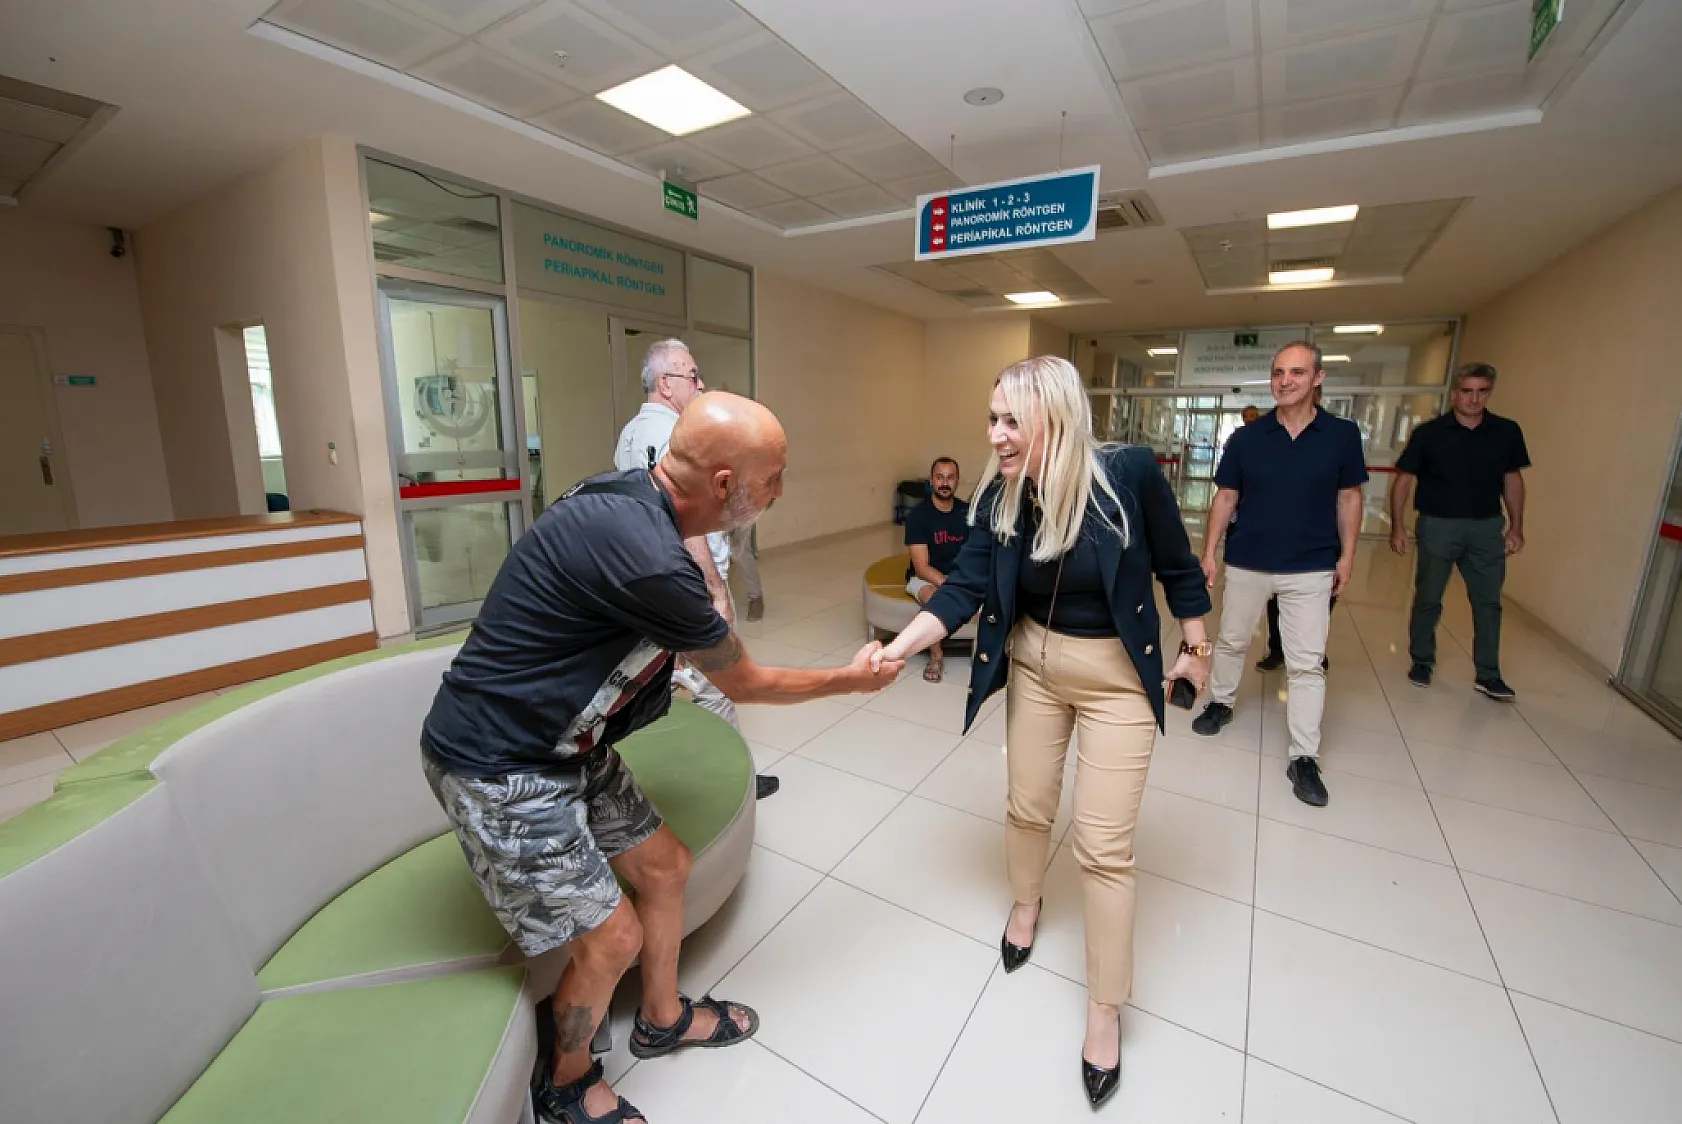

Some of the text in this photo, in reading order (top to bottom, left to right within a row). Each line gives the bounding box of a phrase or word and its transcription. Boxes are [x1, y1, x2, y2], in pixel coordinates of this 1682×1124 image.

[951, 198, 986, 213] KLİNİK
[992, 197, 998, 207] 1
[1007, 195, 1014, 205] 2
[1023, 192, 1030, 203] 3
[951, 202, 1065, 227] PANOROMİK RÖNTGEN
[951, 219, 1073, 244] PERİAPİKAL RÖNTGEN
[616, 252, 664, 274] RÖNTGEN
[616, 275, 665, 296] RÖNTGEN
